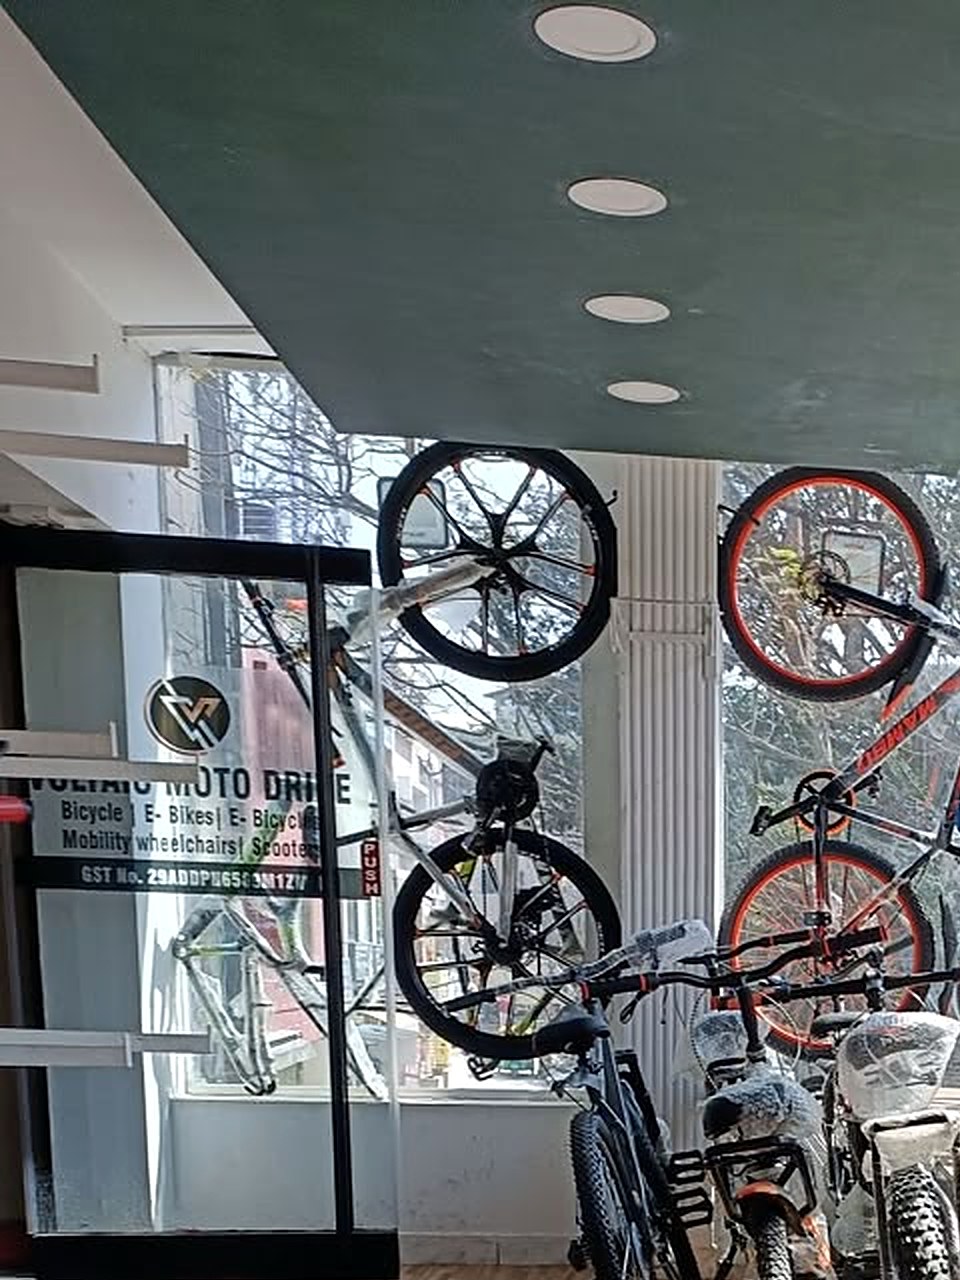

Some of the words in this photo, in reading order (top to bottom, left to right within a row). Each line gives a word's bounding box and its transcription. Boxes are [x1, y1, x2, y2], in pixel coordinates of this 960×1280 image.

[263, 769, 351, 805] DRIE
[61, 799, 124, 825] Bicycle
[62, 829, 132, 854] Mobility
[80, 865, 113, 883] GST
[116, 867, 144, 885] No.
[364, 843, 379, 895] PUSH
